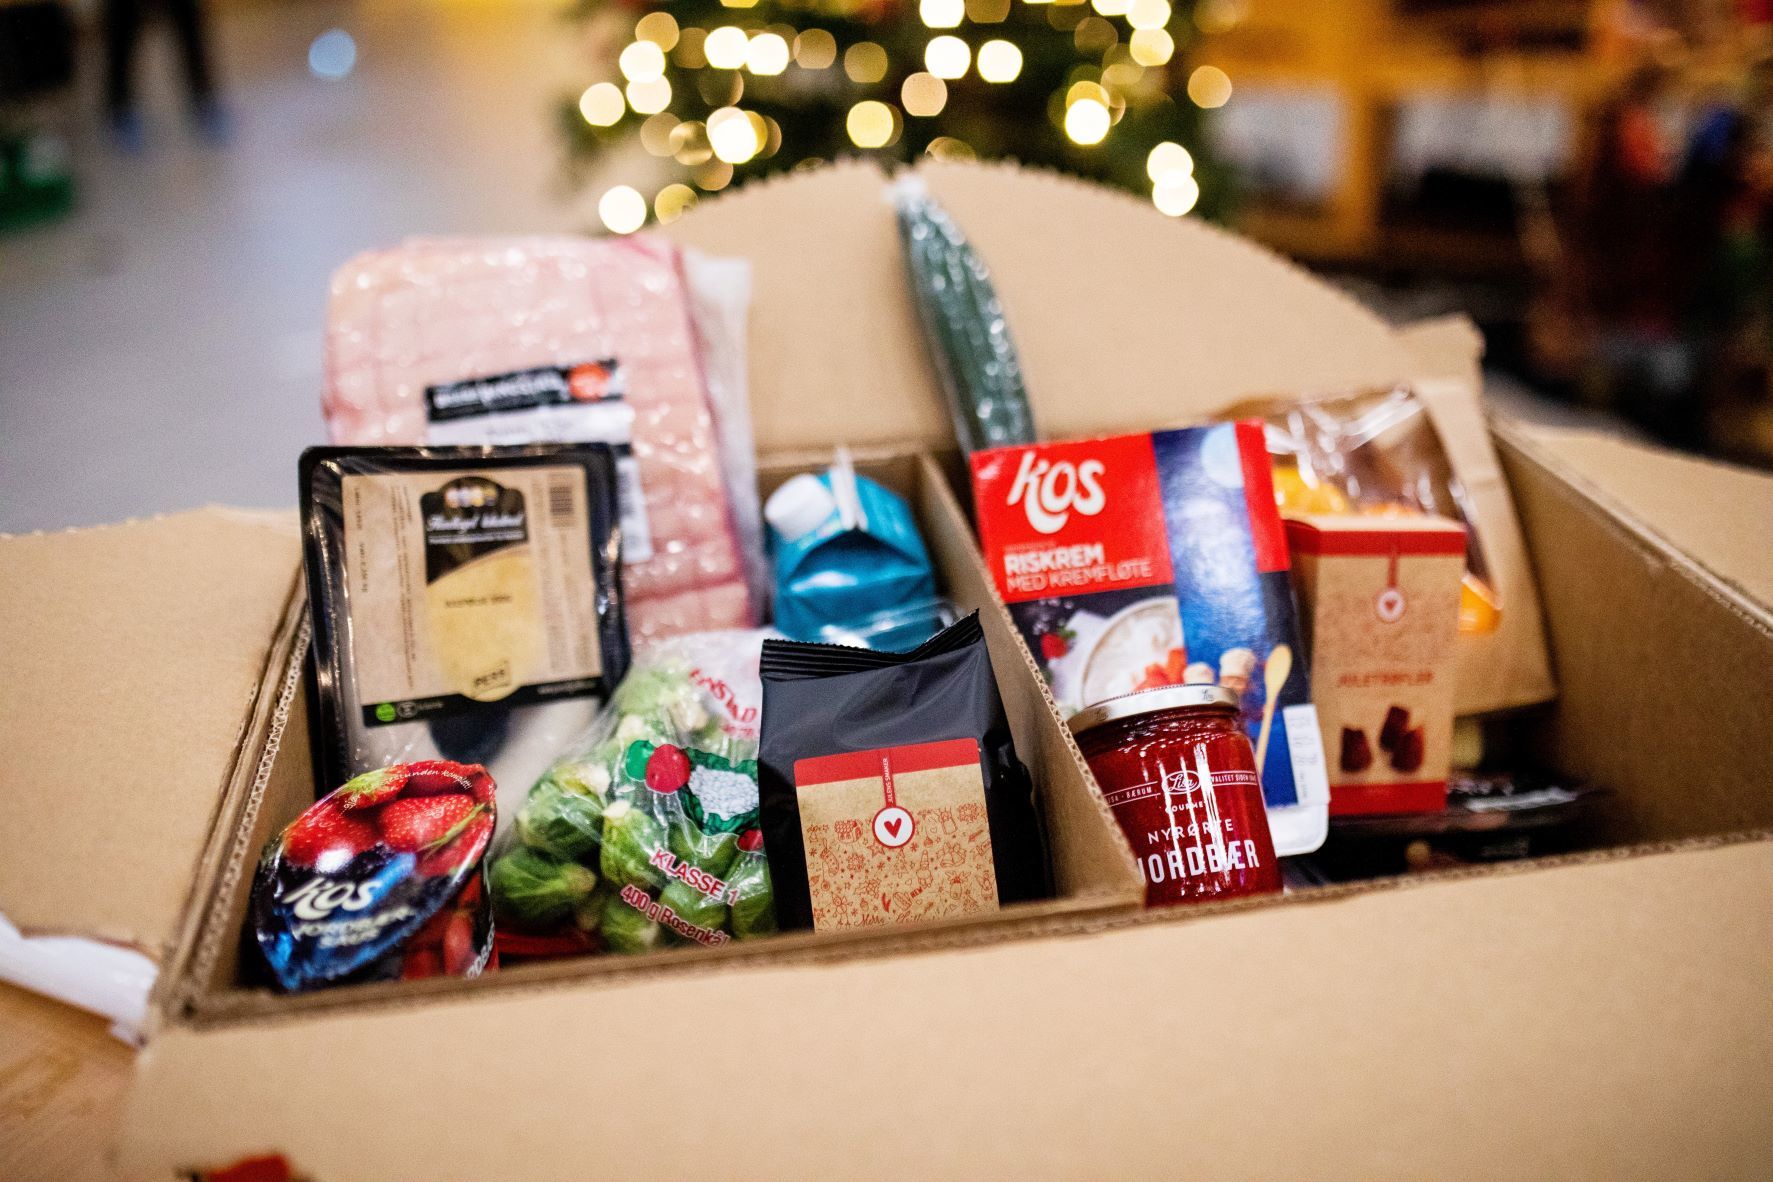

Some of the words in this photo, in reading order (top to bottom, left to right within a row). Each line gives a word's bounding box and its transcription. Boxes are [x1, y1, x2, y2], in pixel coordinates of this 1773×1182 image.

[1004, 543, 1105, 576] RISKREM
[1006, 573, 1048, 593] MED
[1209, 773, 1235, 783] VALITET
[1147, 818, 1234, 845] NYRØRE
[650, 849, 727, 900] KLASSE
[727, 888, 740, 906] 1
[621, 885, 650, 912] 400
[646, 903, 661, 921] g
[660, 906, 730, 948] Rosenkål
